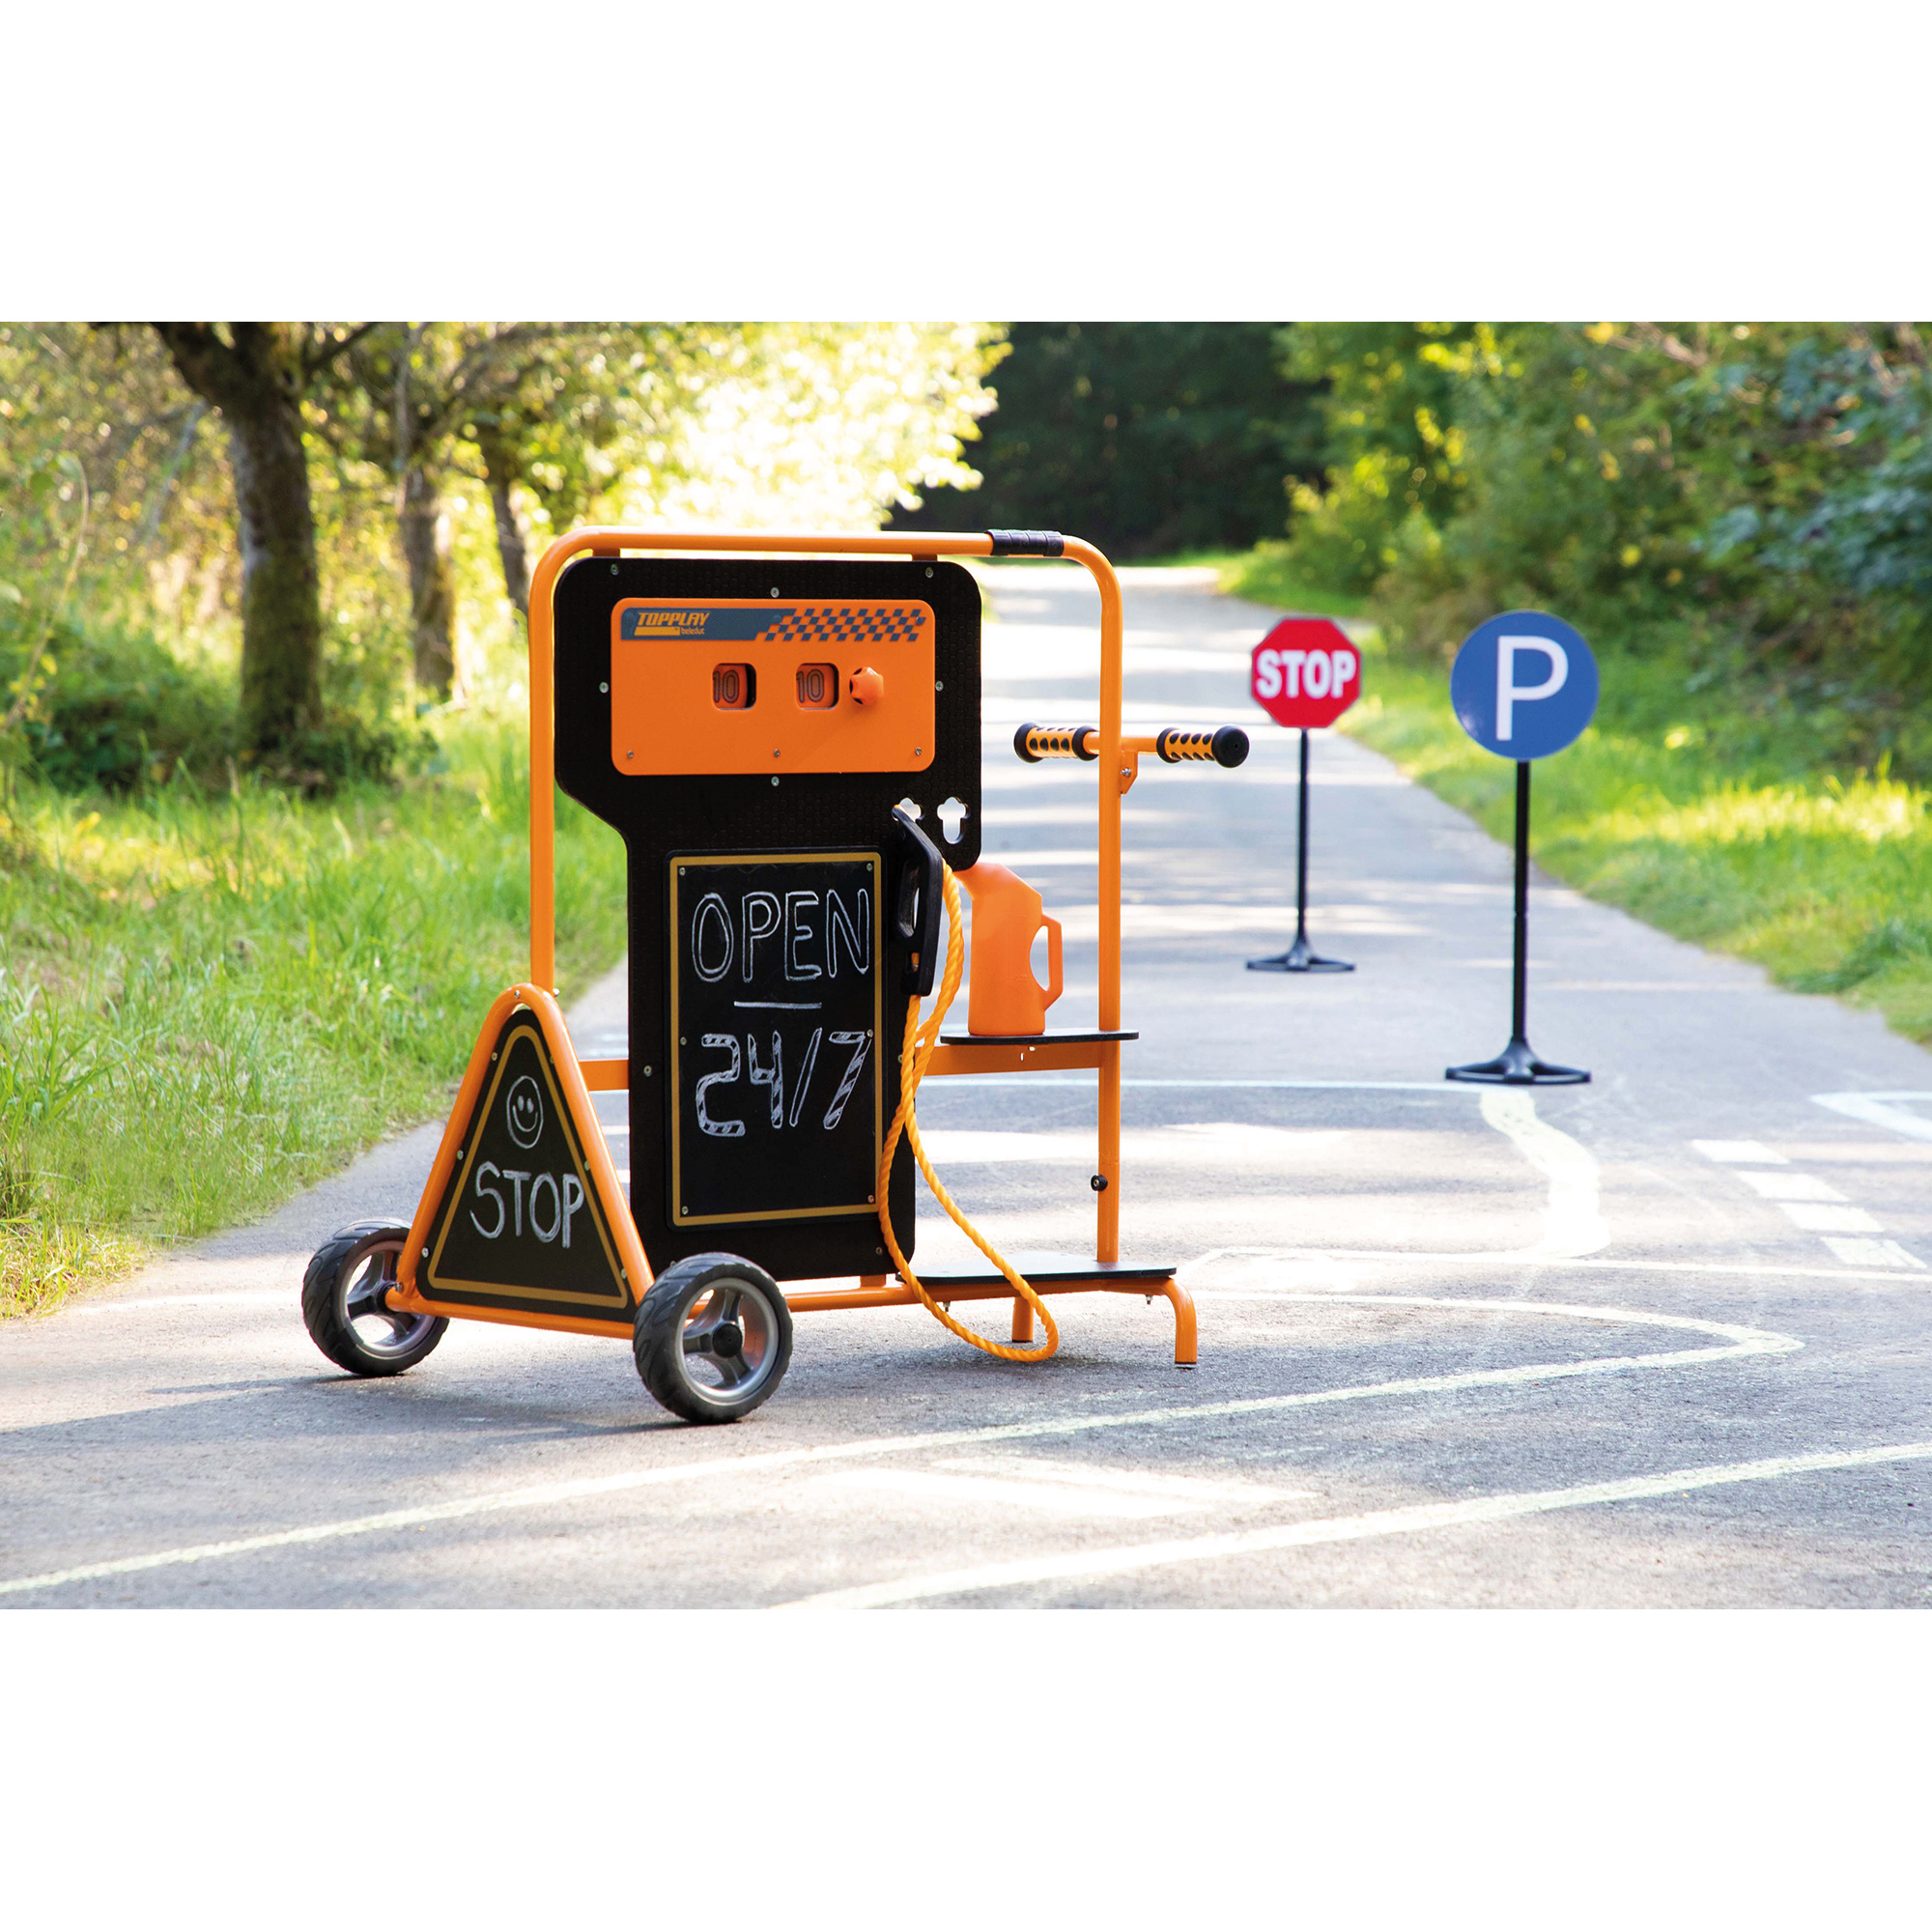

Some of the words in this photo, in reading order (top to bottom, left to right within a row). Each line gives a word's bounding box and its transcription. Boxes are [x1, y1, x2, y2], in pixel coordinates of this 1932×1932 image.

[638, 611, 710, 626] TOPPLAY
[713, 670, 739, 703] 10
[796, 668, 824, 703] 10
[1256, 649, 1356, 698] STOP
[1496, 636, 1569, 741] P
[692, 889, 869, 982] OPEN
[696, 1027, 872, 1137] 24/7
[469, 1161, 584, 1248] STOP
